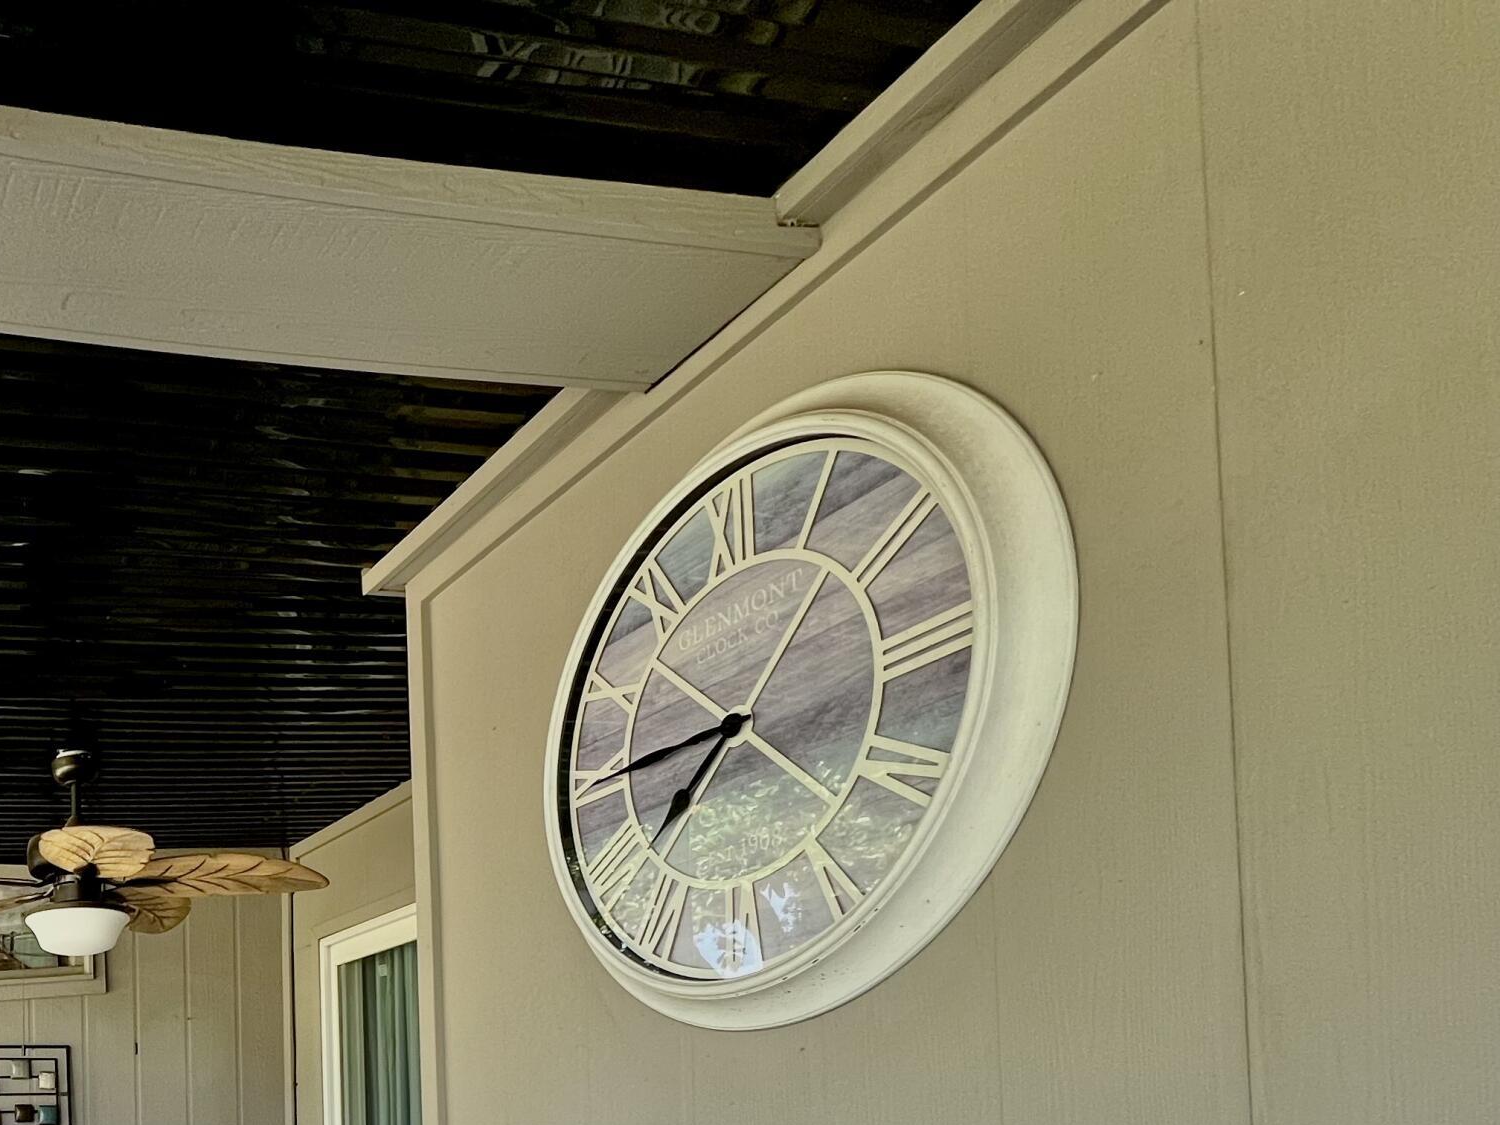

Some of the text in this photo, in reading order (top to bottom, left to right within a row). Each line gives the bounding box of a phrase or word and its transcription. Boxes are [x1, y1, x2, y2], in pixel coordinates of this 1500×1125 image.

[703, 470, 756, 586] XII
[851, 485, 939, 591] II
[629, 556, 687, 645] XI
[678, 567, 804, 651] GLENMONT
[881, 599, 973, 683] III
[696, 627, 749, 664] CLOCK
[583, 670, 641, 713] X
